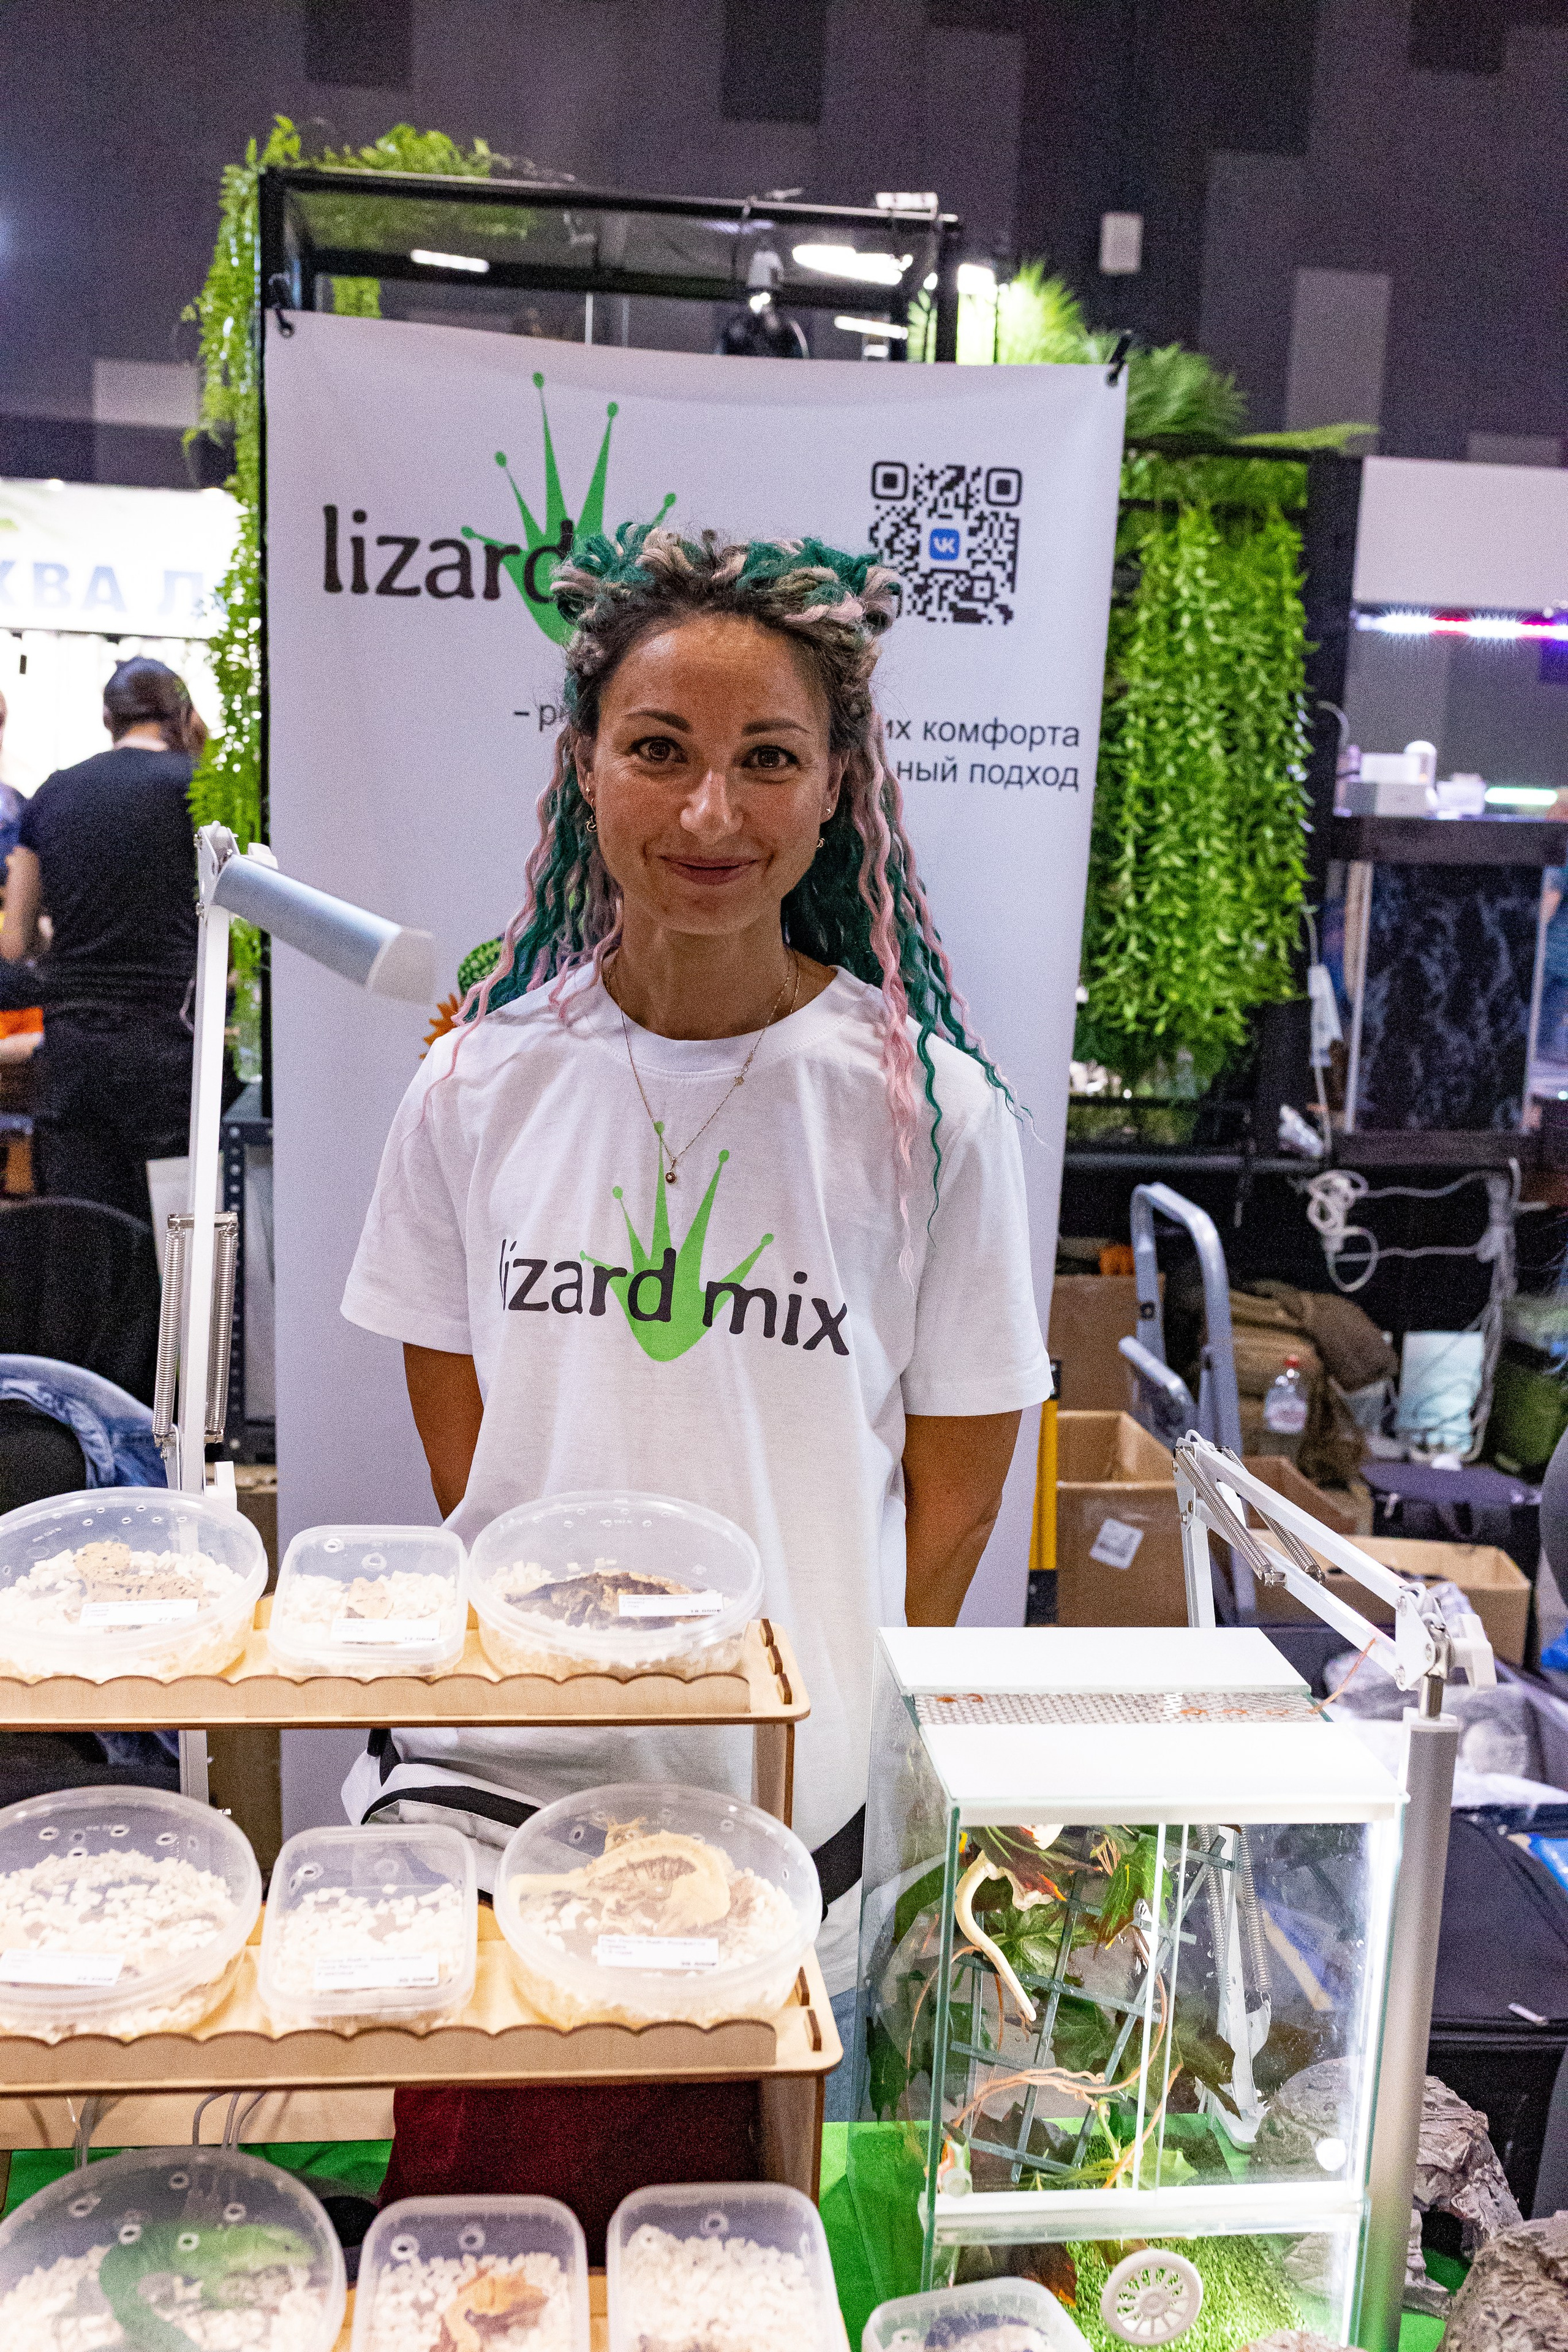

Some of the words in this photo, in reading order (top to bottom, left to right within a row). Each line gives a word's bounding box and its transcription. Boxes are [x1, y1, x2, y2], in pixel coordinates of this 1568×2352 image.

[323, 503, 574, 603] lizard
[923, 716, 1080, 752] комфорта
[970, 763, 1079, 793] подход
[702, 1271, 850, 1356] mix
